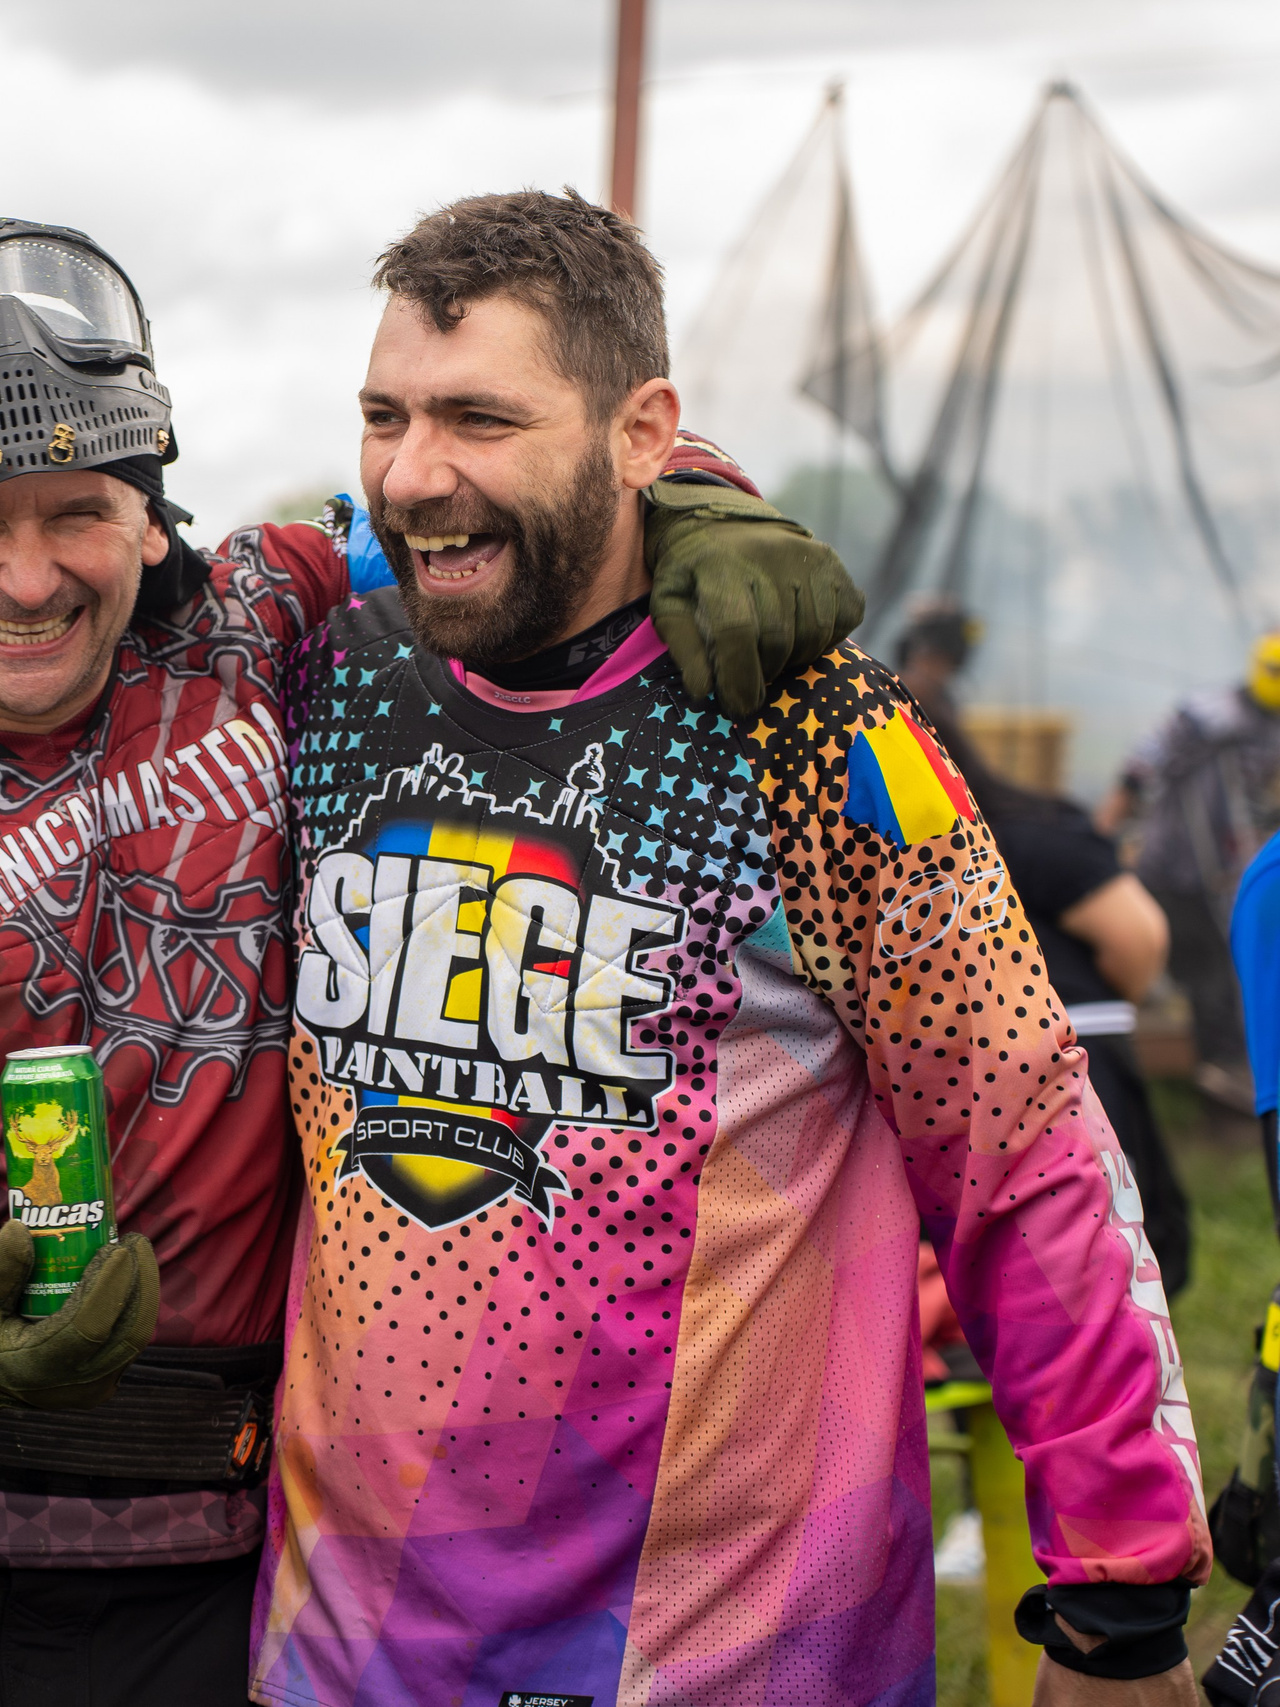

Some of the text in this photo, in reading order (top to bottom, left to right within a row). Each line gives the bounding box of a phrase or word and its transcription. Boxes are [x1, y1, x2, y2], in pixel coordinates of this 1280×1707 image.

[295, 852, 680, 1081] SIEGE
[323, 1036, 648, 1123] PAINTBALL
[356, 1118, 525, 1171] SPORT CLUB
[524, 1697, 569, 1707] JERSEY
